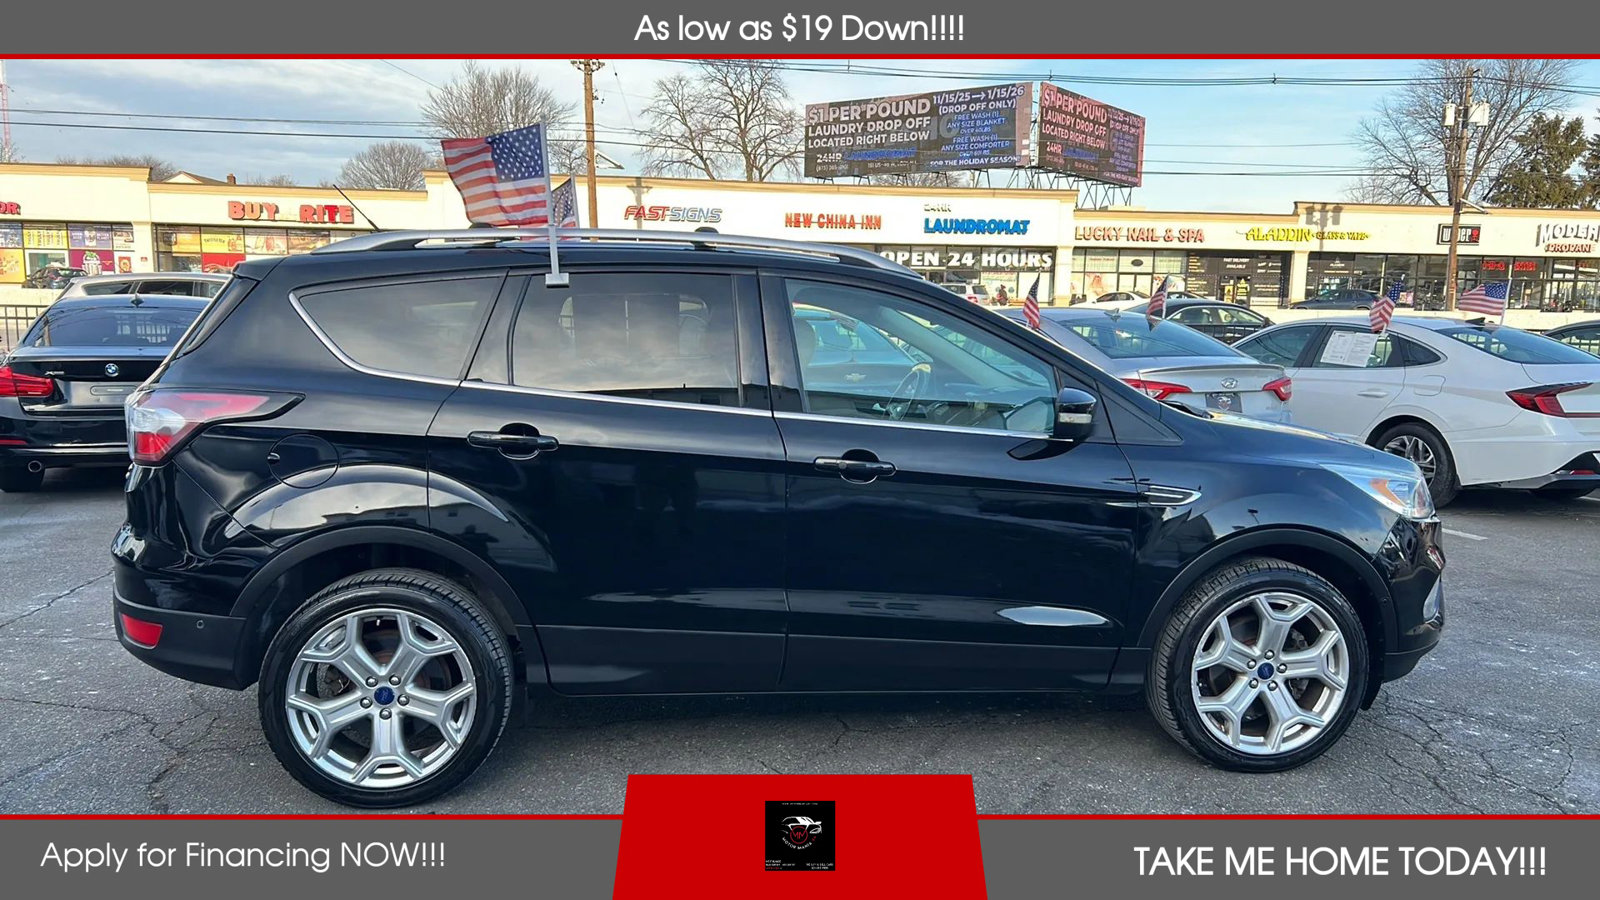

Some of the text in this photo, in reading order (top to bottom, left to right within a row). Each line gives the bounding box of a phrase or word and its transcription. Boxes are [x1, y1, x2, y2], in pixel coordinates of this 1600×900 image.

[933, 86, 1024, 105] 11/15/25 1/15/26
[829, 106, 861, 122] PER
[866, 98, 931, 118] POUND
[938, 98, 1017, 115] (DROP OFF ONLY)
[1056, 93, 1074, 113] PER
[1076, 100, 1107, 123] POUND
[946, 121, 960, 129] ANY
[961, 120, 975, 128] SIZE
[954, 112, 970, 121] FREE
[971, 111, 991, 119] WASH
[1043, 108, 1075, 128] LAUNDRY
[1075, 118, 1094, 133] DROP
[808, 116, 931, 137] LAUNDRY DROP OFF
[808, 130, 930, 149] LOCATED RIGHT BELOW
[952, 136, 969, 144] FREE
[1042, 123, 1069, 138] LOCATED
[1087, 136, 1106, 150] BELOW
[941, 144, 955, 152] ANY
[228, 201, 354, 224] BUY RITE
[624, 205, 723, 223] FASTSIGNS
[785, 213, 882, 229] NEW CHINA INN
[924, 217, 1030, 235] LAUNDROMAT
[1075, 226, 1205, 242] LUCKY NAIL & SPA
[1245, 227, 1311, 242] ALADDIN
[1536, 223, 1600, 247] MODER
[880, 250, 1053, 269] OPEN 24 HOURS
